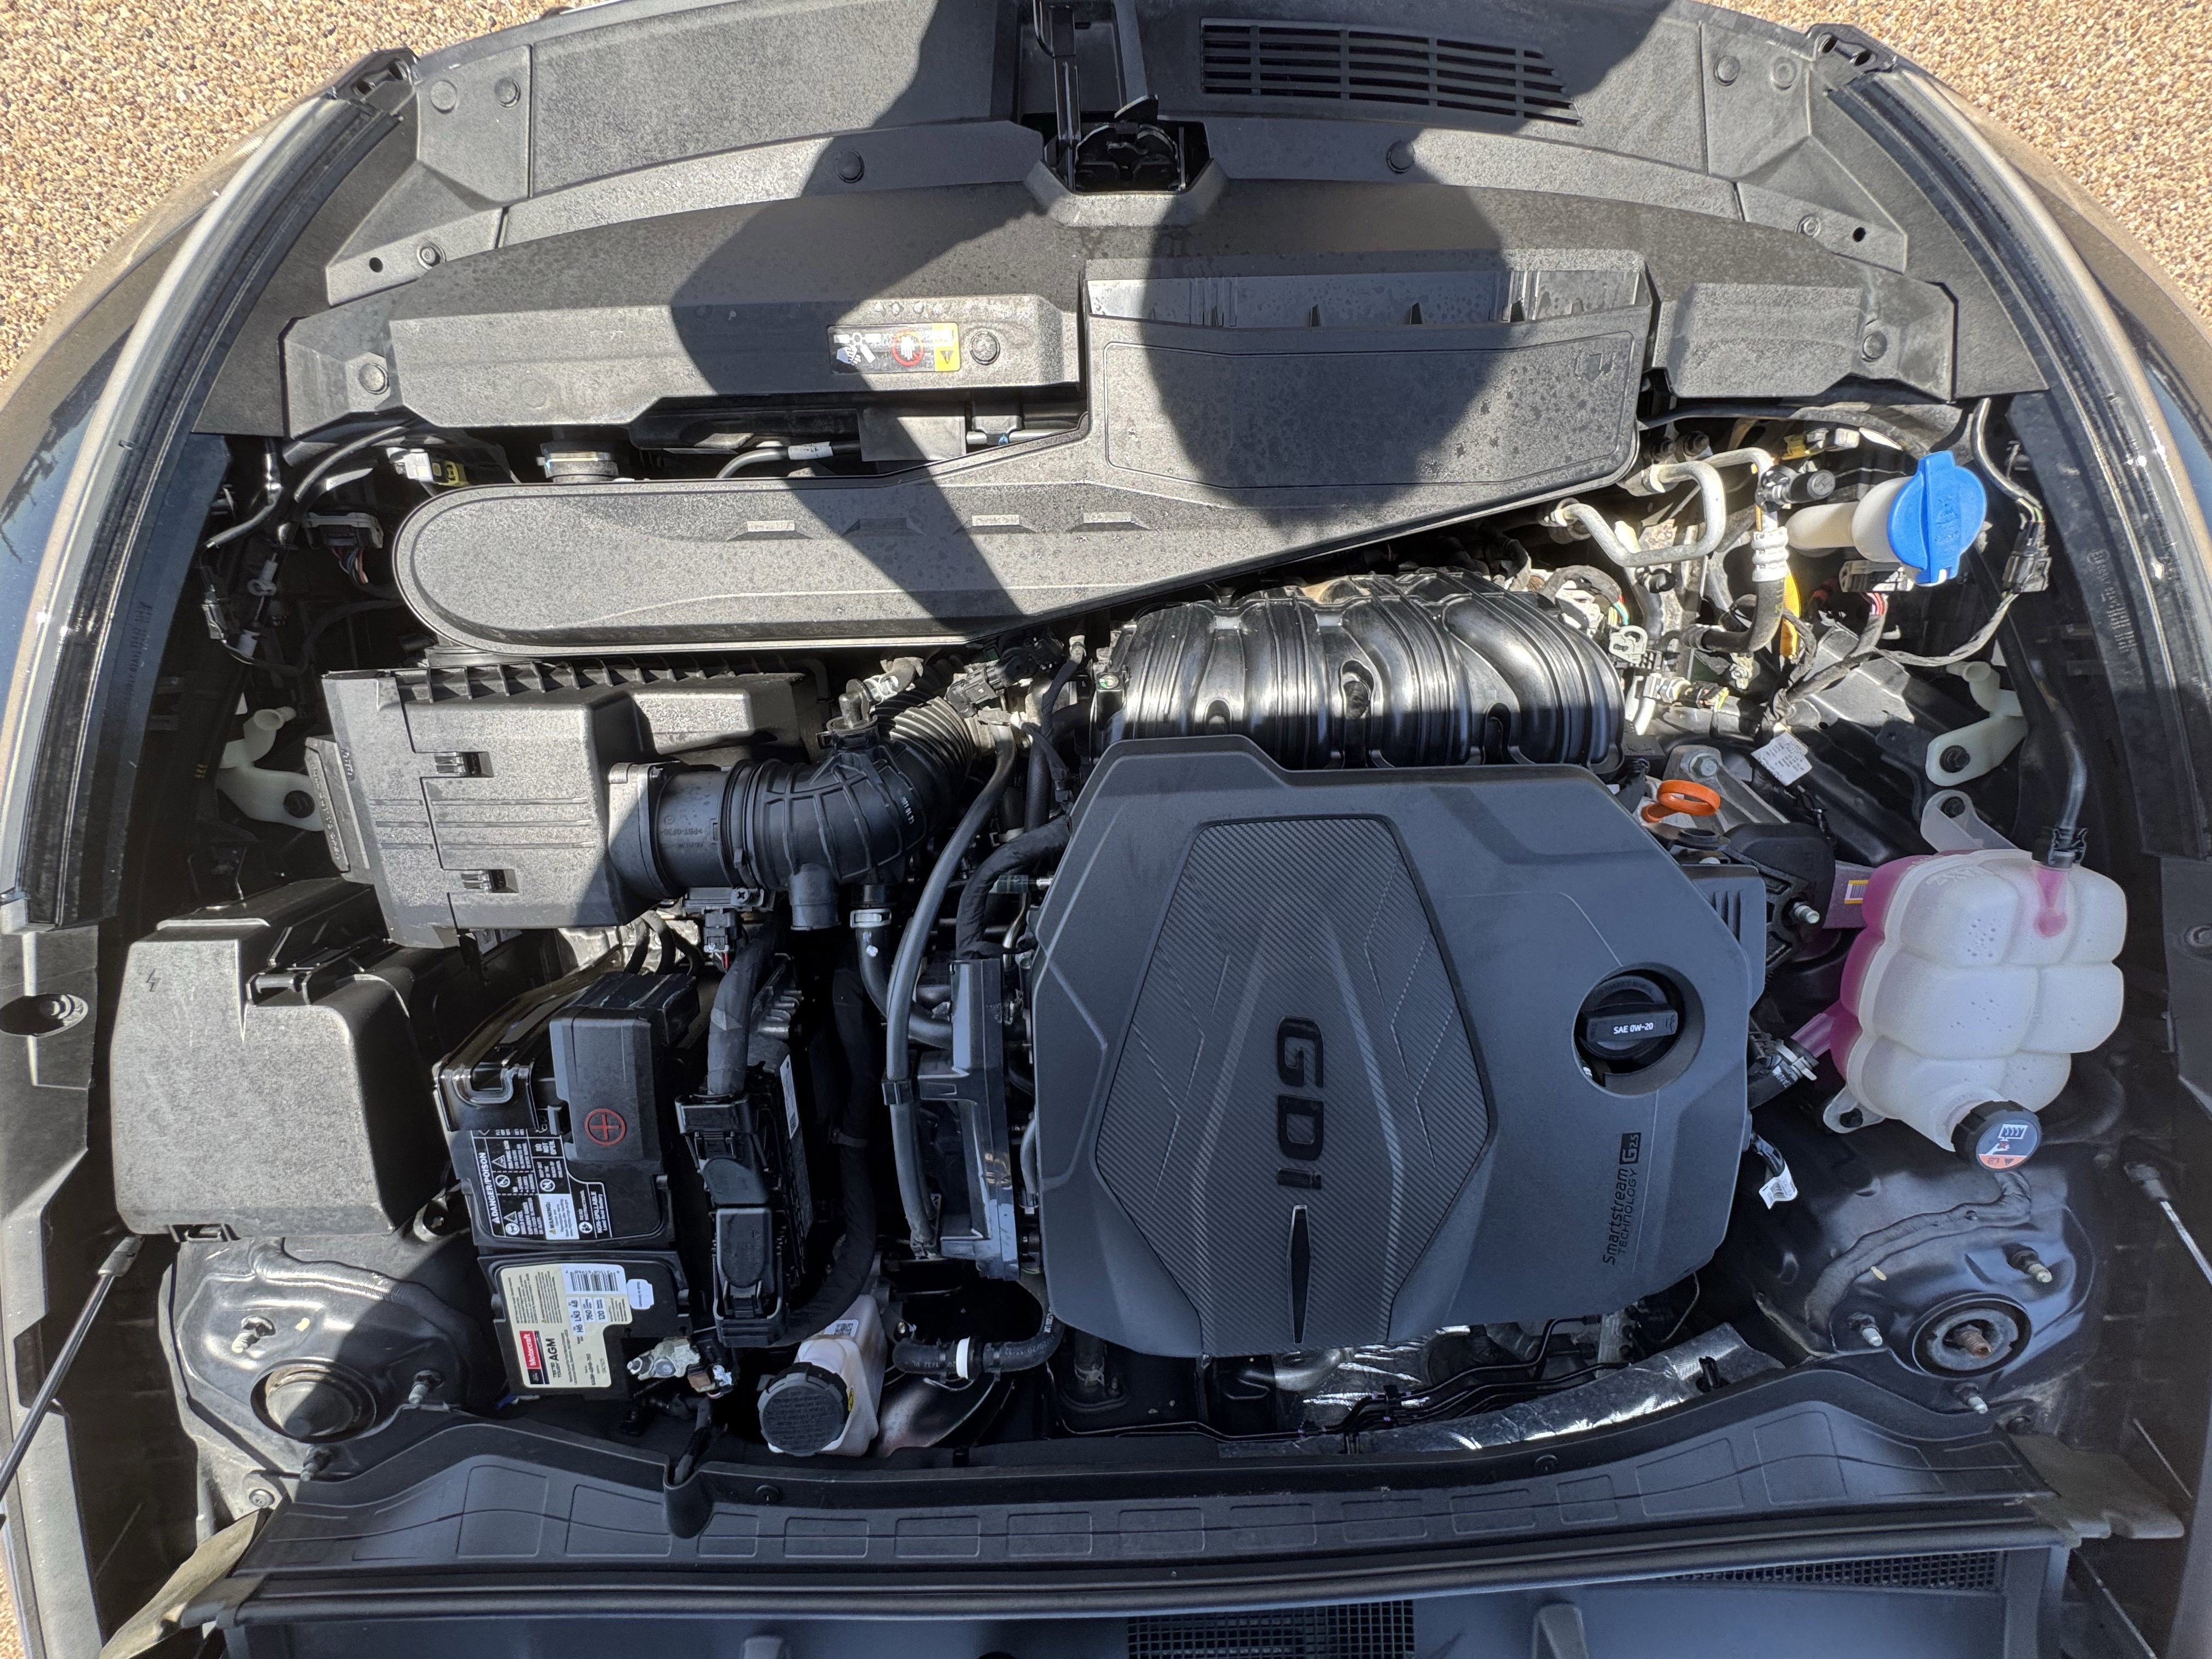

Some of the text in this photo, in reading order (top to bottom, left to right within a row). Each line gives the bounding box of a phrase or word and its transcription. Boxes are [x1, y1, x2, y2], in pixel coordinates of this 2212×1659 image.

[1613, 1022, 1654, 1034] SAE 0W-20
[1276, 1015, 1324, 1190] GDi
[479, 1152, 499, 1217] DANGER/POISON
[545, 1201, 555, 1229] WARNING:
[590, 1191, 603, 1233] NON-SPILLABLE
[1602, 1168, 1628, 1266] Smartstream
[1618, 1168, 1638, 1255] TECHNOLOGY
[573, 1311, 582, 1322] LN3
[576, 1324, 584, 1333] H6
[585, 1310, 594, 1321] 760
[597, 1311, 606, 1321] 120
[524, 1333, 536, 1366] Motorcraft
[545, 1339, 558, 1361] AGM
